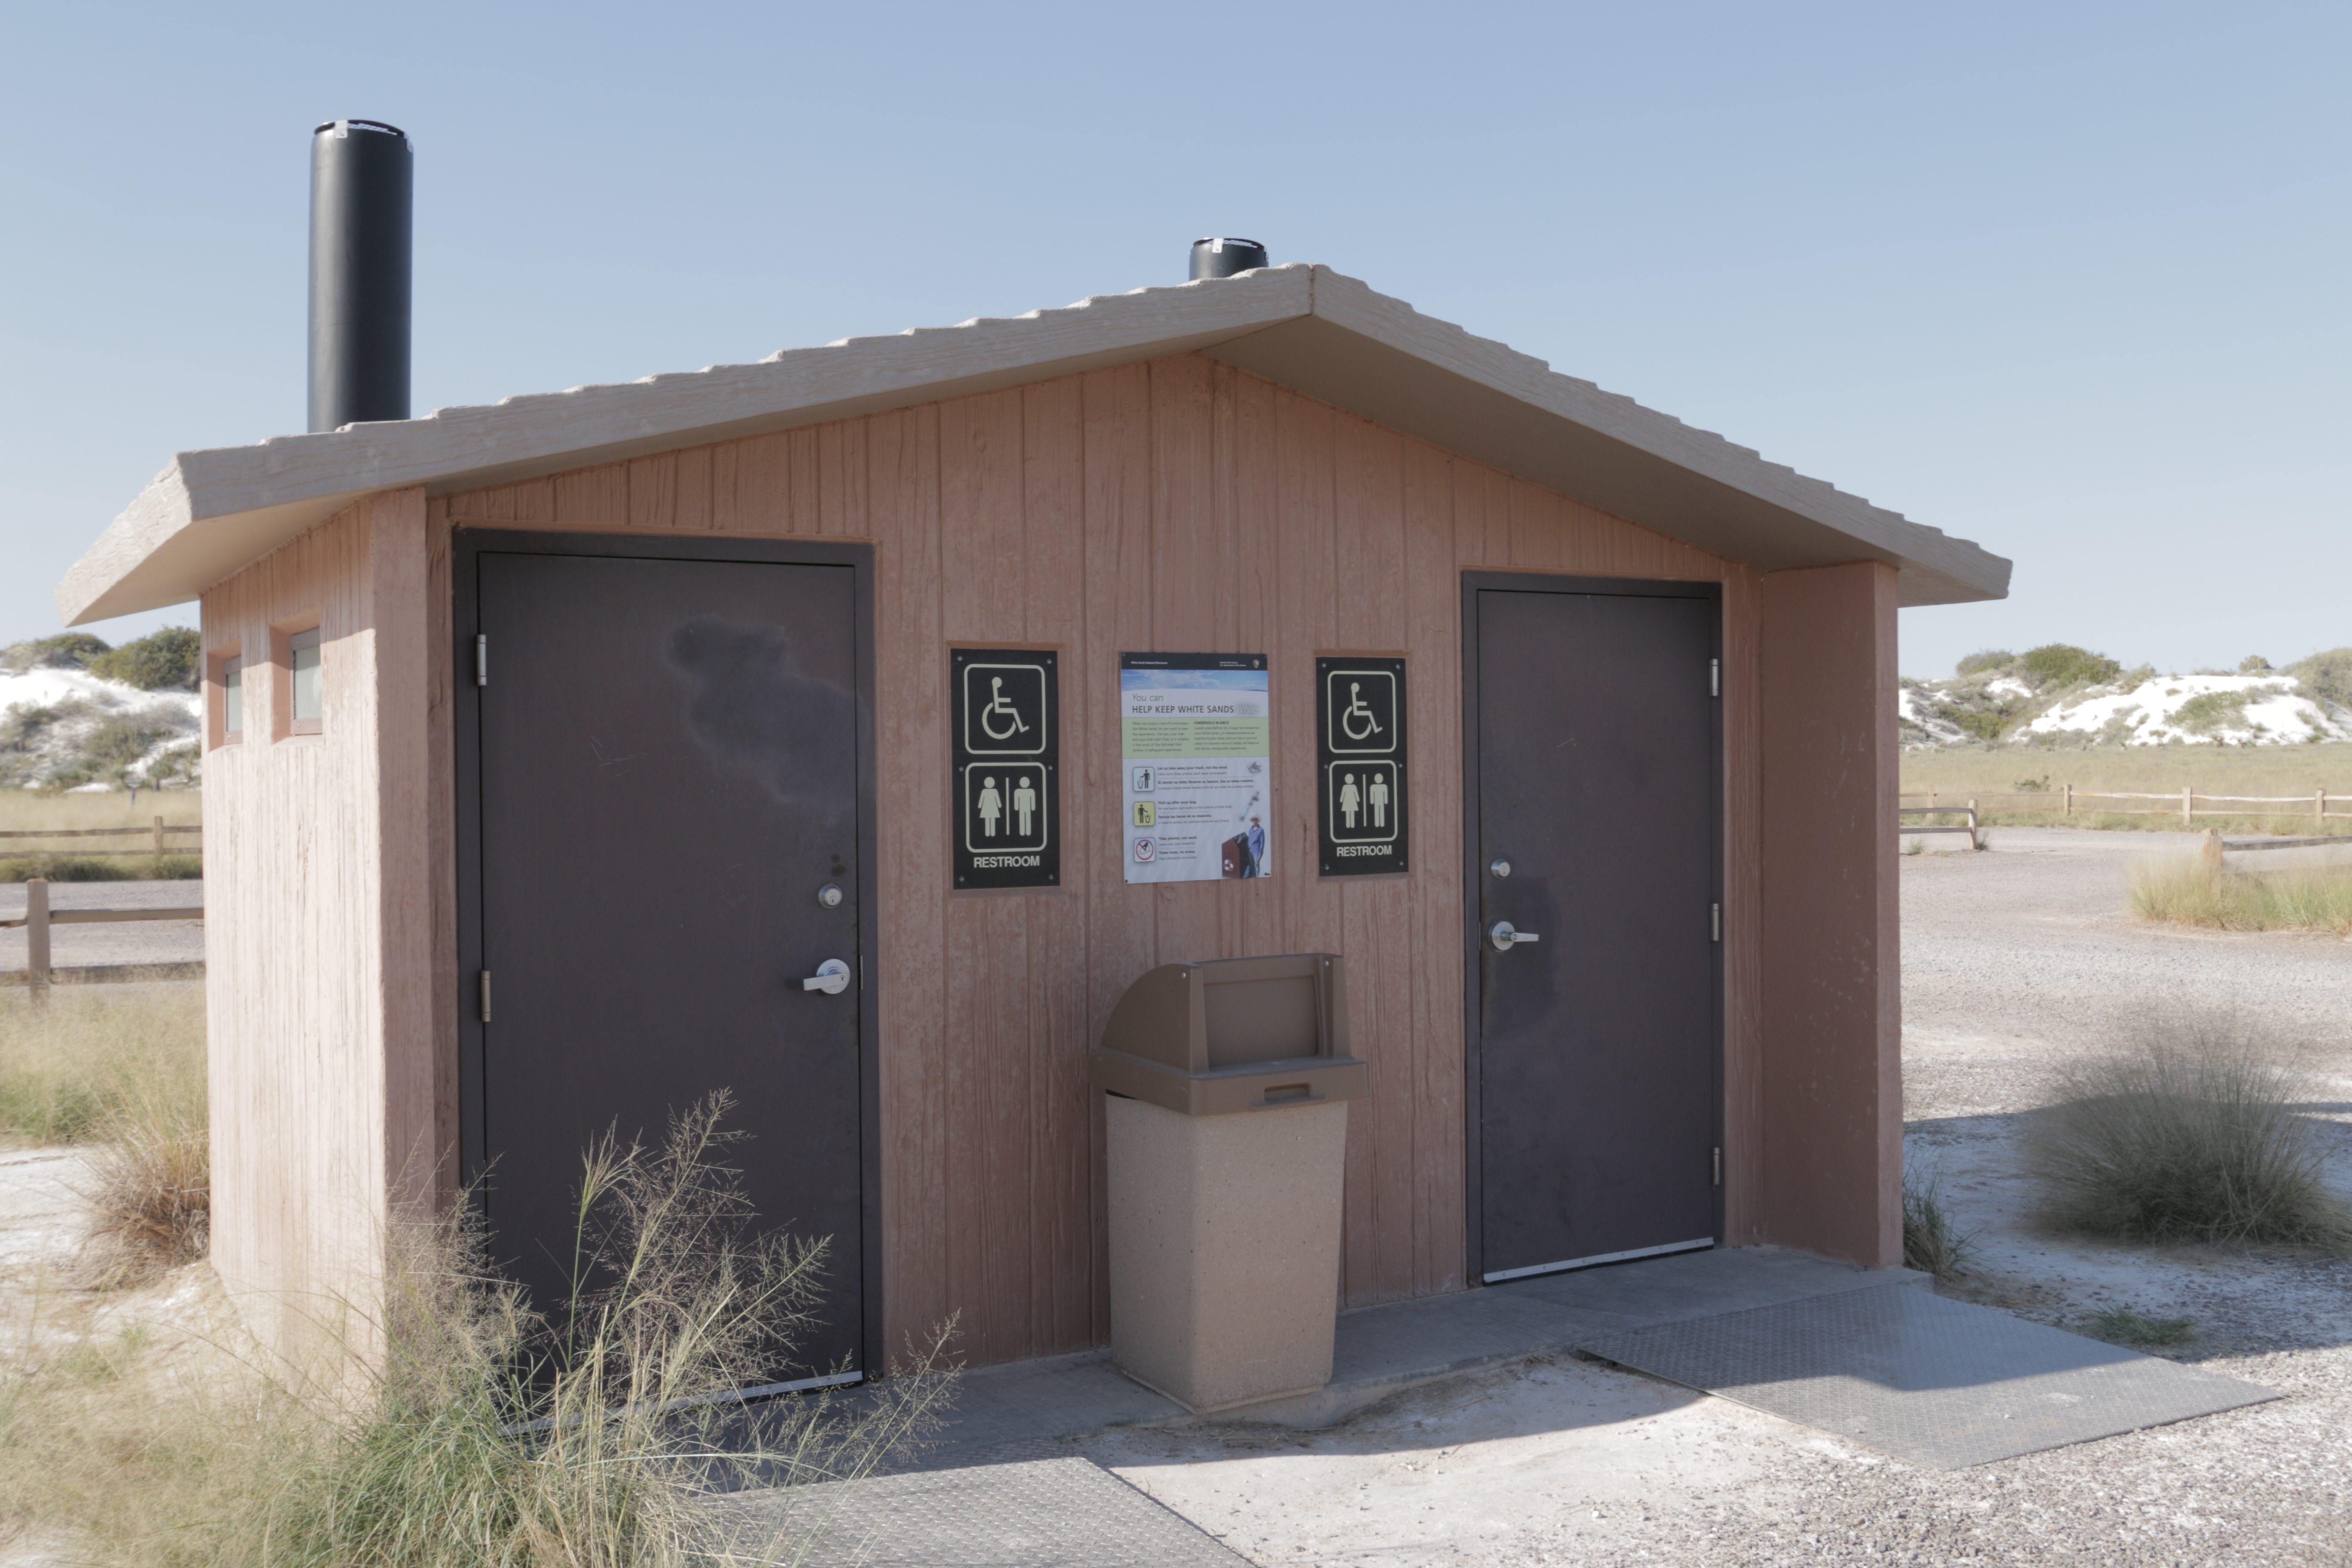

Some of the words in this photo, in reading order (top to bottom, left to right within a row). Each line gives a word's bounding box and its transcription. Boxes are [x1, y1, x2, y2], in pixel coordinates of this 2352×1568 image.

[1132, 693, 1146, 701] You
[1149, 693, 1164, 701] can
[1337, 845, 1392, 857] RESTROOM
[974, 856, 1040, 868] RESTROOM
